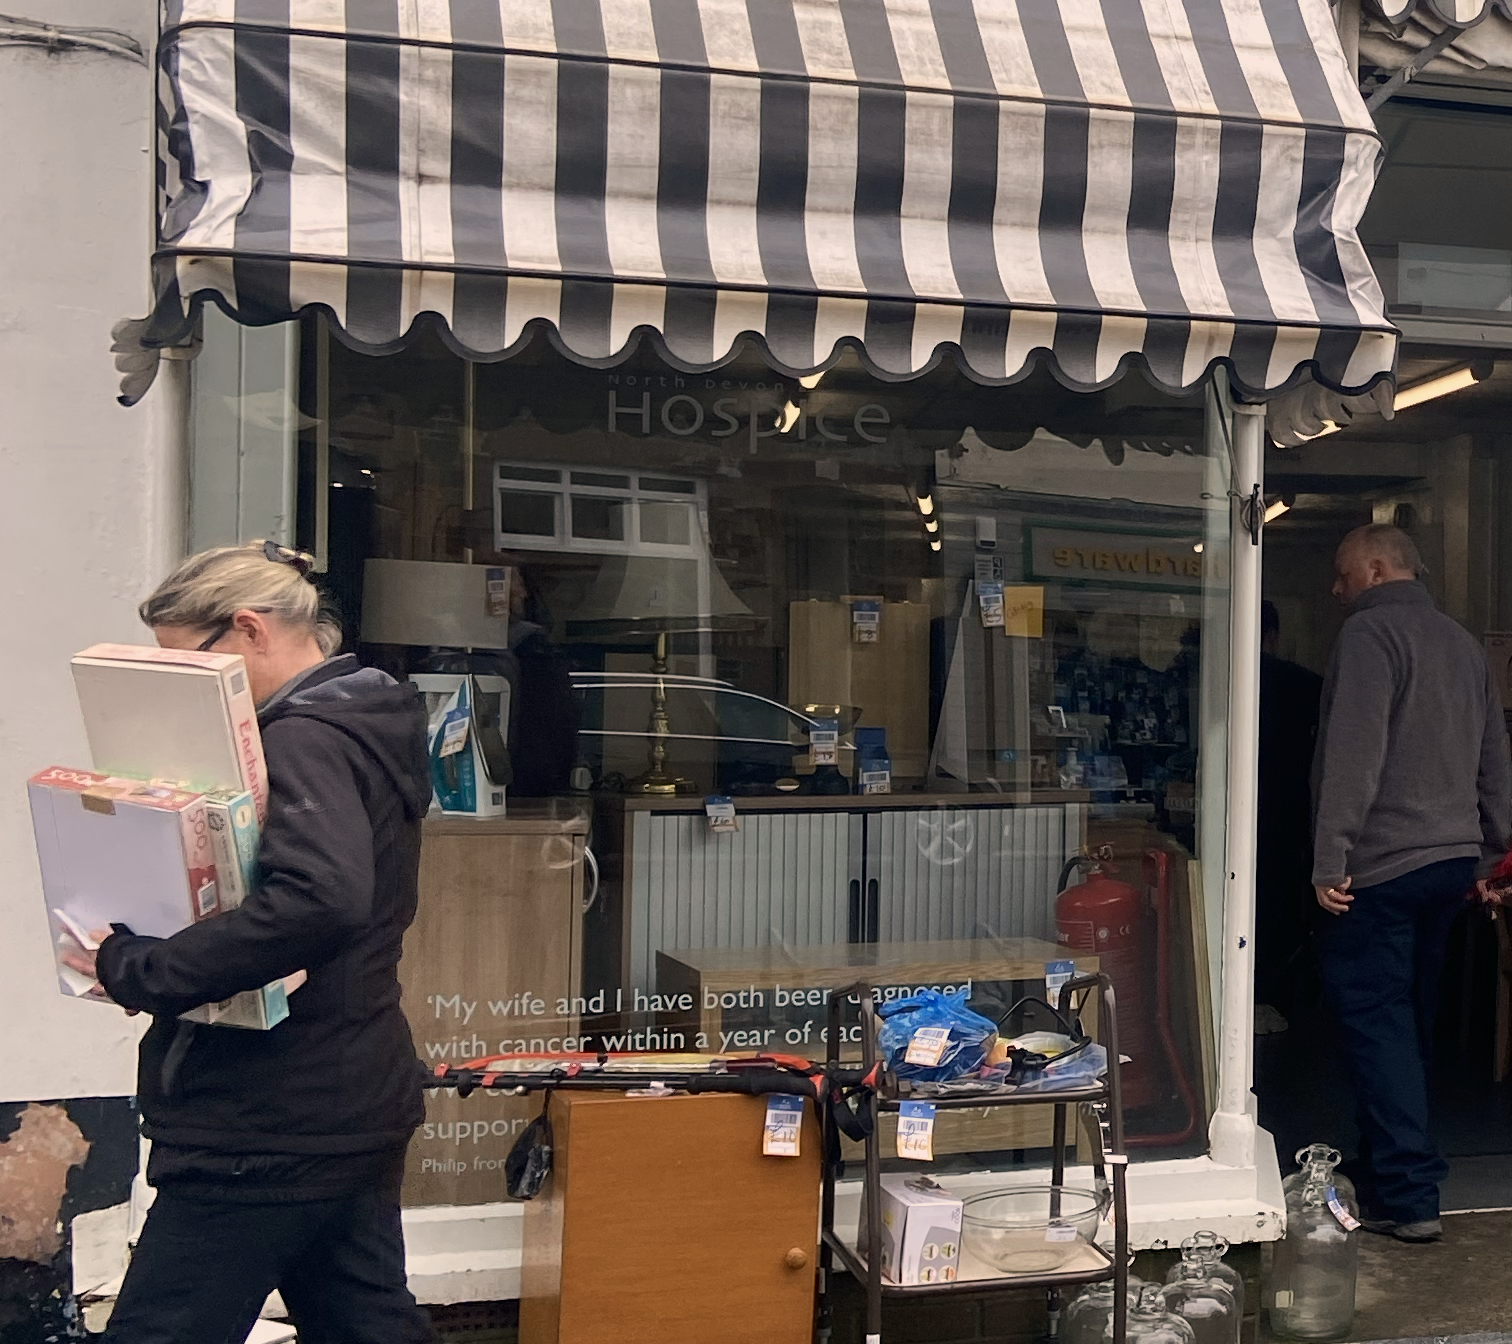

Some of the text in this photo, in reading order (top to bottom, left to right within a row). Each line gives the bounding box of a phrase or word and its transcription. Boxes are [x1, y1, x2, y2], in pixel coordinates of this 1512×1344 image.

[607, 374, 785, 392] North Devon
[607, 389, 891, 454] Hospice
[487, 991, 545, 1017] wife
[555, 989, 605, 1016] and
[615, 988, 623, 1013] I
[633, 987, 693, 1012] have
[703, 984, 765, 1010] both
[425, 1033, 487, 1059] with
[498, 1033, 592, 1056] cancer
[601, 1027, 685, 1052] within
[695, 1031, 709, 1049] a
[718, 1028, 776, 1054] year
[785, 1019, 813, 1045] of
[420, 1158, 467, 1176] Philip
